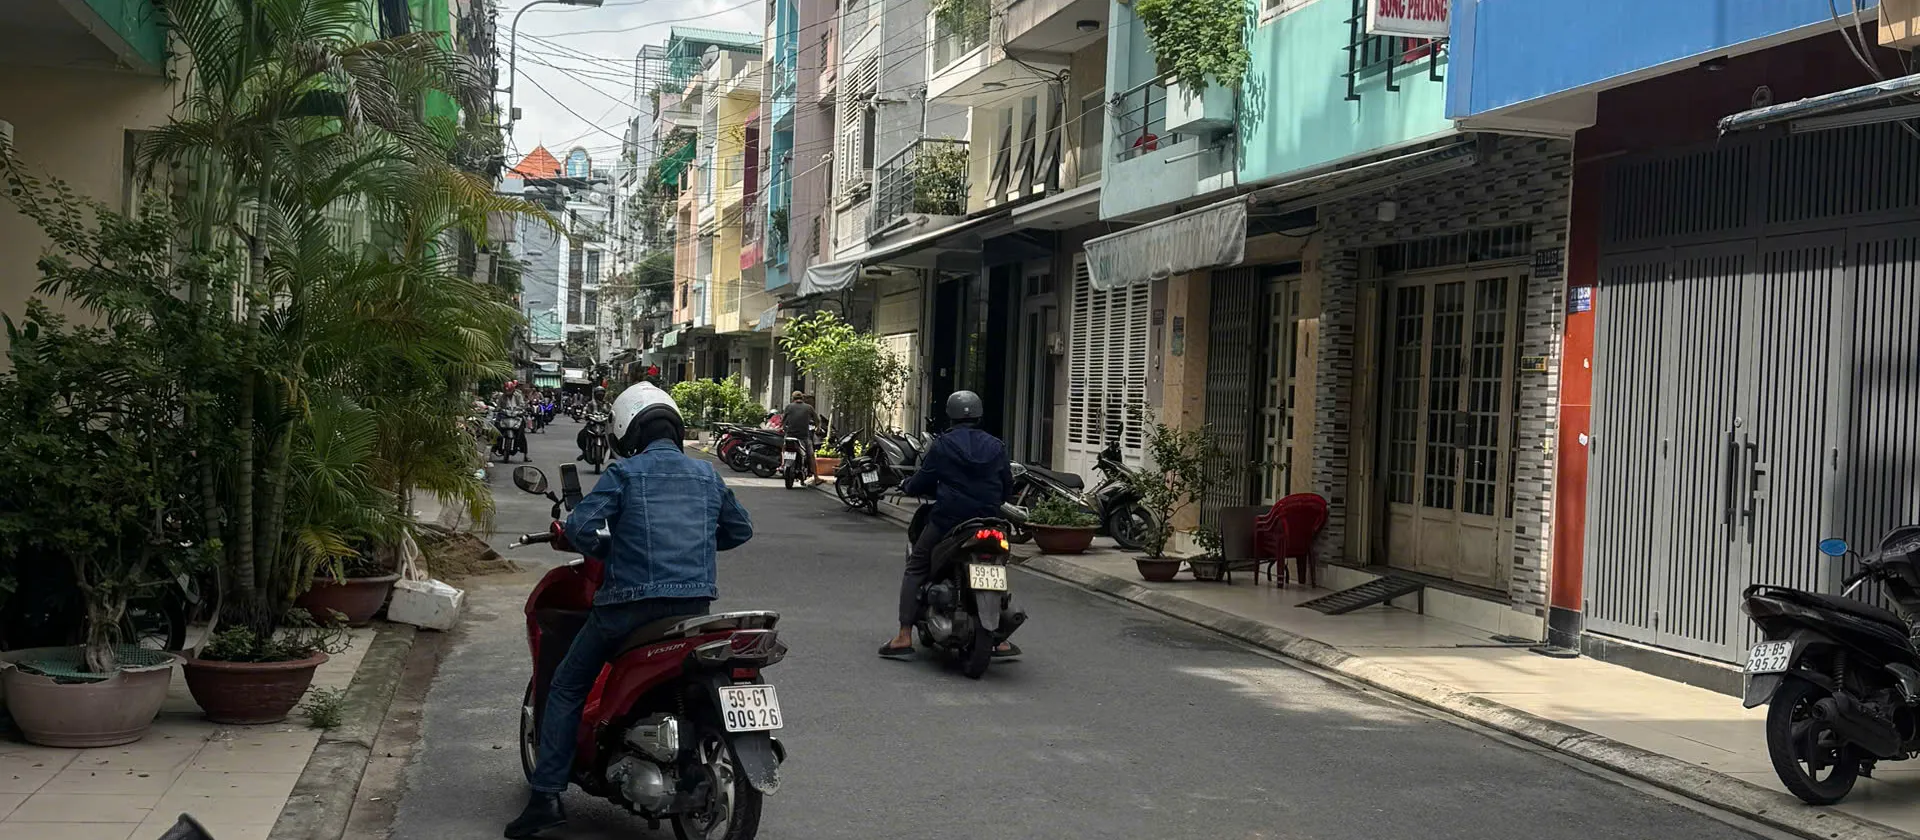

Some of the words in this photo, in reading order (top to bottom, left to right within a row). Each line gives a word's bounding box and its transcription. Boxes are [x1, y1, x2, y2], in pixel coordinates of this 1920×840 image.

[975, 566, 999, 578] 59-C1
[647, 642, 687, 658] VISION
[1754, 643, 1786, 657] 63-B5
[1745, 656, 1787, 671] 295.27
[728, 689, 767, 708] 59-G1
[727, 708, 778, 728] 909.26
